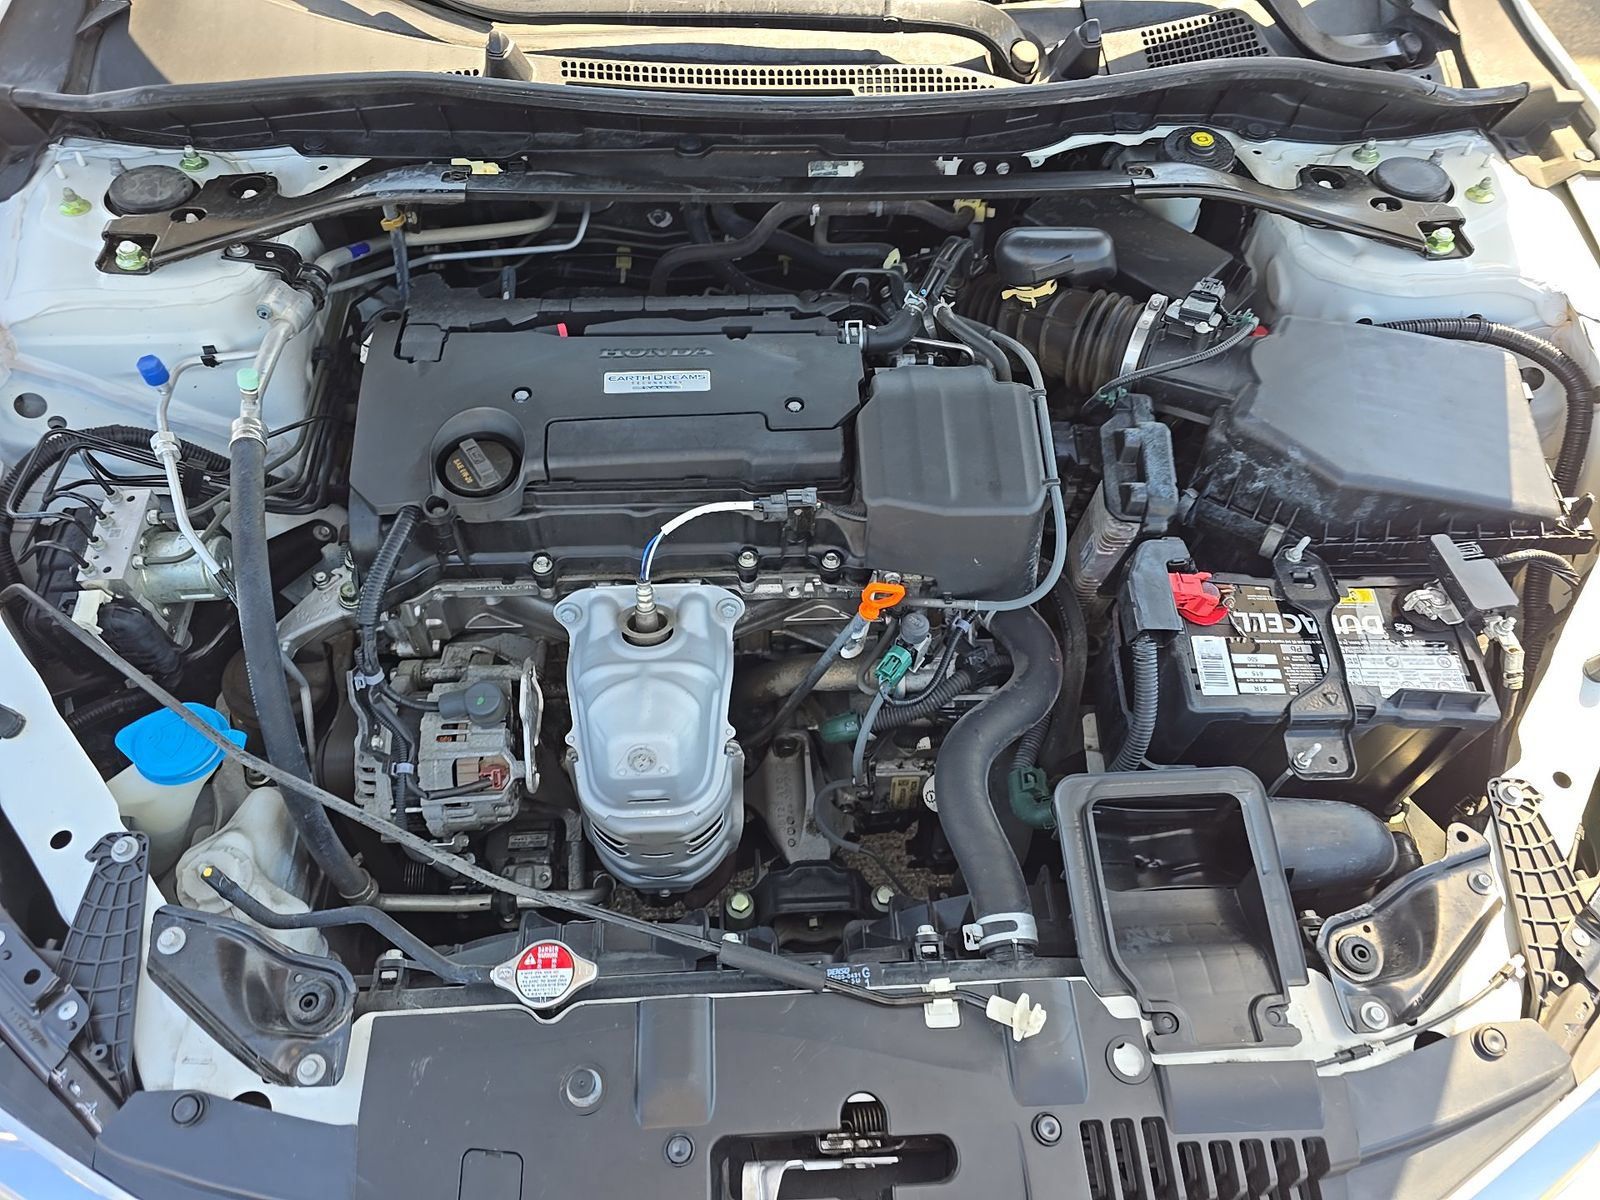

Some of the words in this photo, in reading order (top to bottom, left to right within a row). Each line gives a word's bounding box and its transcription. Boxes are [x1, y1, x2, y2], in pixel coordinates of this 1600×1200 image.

[599, 347, 714, 358] HONDA
[653, 373, 706, 381] DREAMS
[861, 966, 871, 978] G
